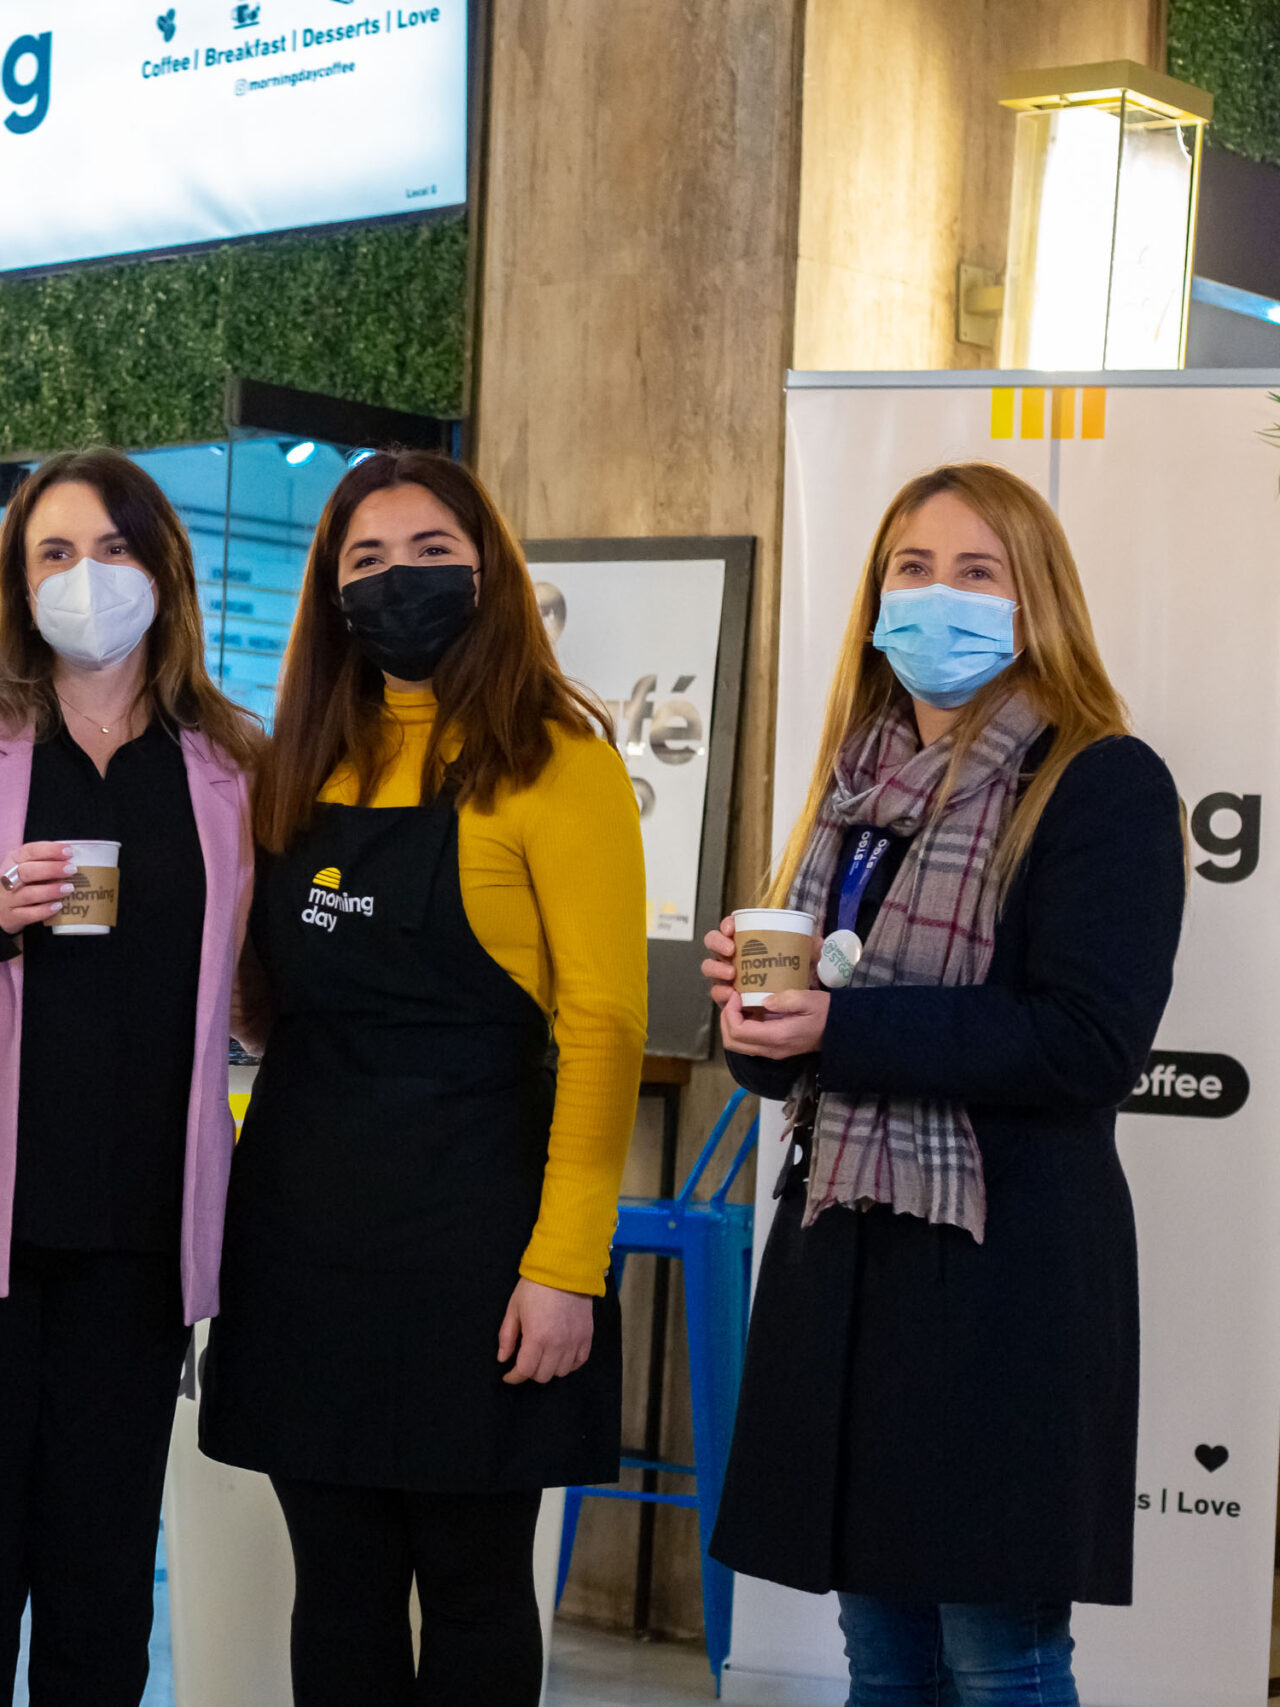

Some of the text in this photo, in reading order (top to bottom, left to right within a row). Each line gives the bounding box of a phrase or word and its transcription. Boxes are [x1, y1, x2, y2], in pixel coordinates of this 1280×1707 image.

[141, 54, 191, 79] Coffee
[204, 35, 287, 67] Breakfast
[302, 18, 381, 48] Desserts
[397, 6, 441, 29] Love
[853, 830, 871, 861] STGO
[60, 903, 91, 918] day
[301, 905, 338, 933] day
[740, 952, 801, 971] morning
[740, 971, 769, 988] day
[1131, 1064, 1223, 1100] offee
[1177, 1490, 1241, 1518] Love
